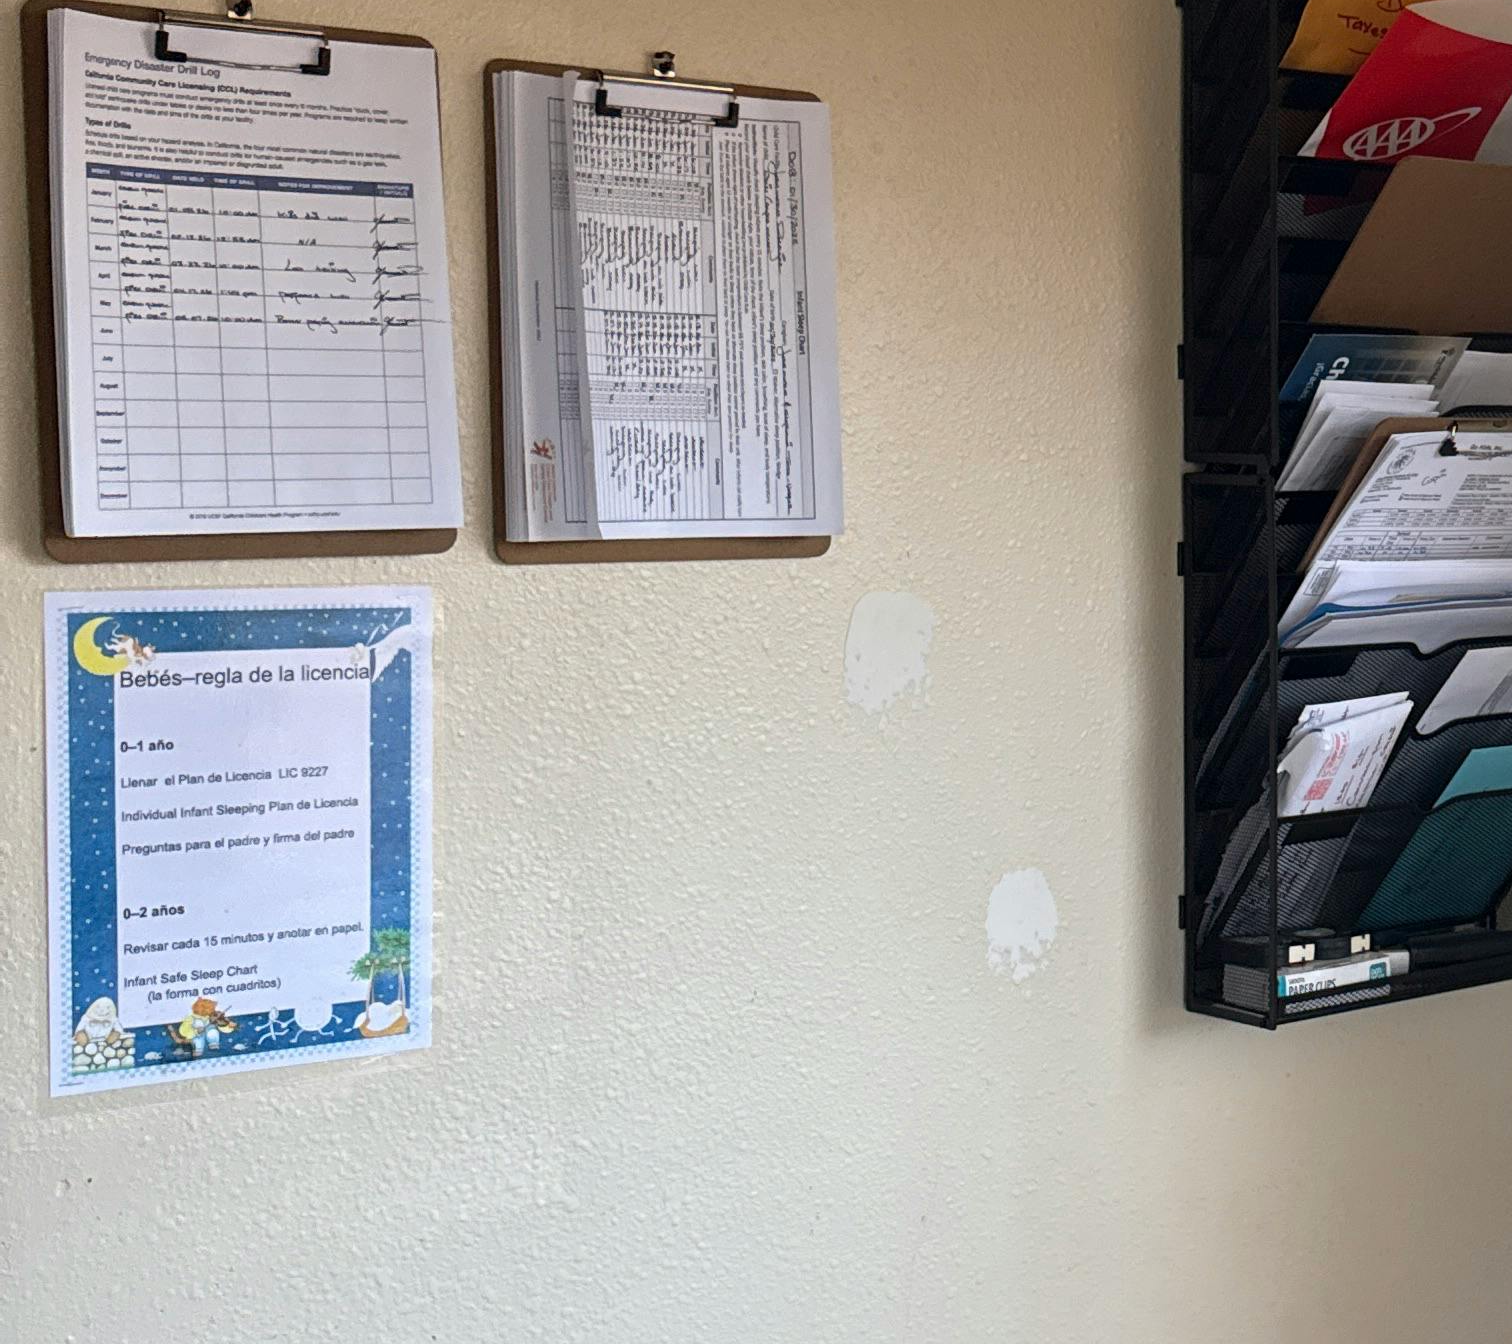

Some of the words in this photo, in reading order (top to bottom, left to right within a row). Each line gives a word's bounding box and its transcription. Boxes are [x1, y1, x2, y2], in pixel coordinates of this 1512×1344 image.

[85, 52, 132, 70] Emergency
[134, 59, 174, 73] Disaster
[178, 64, 197, 74] Drill
[201, 66, 220, 78] Log
[1350, 116, 1430, 157] AAA
[249, 667, 272, 682] de
[279, 665, 295, 681] la
[301, 663, 370, 681] licencia
[149, 739, 174, 751] año
[121, 778, 158, 788] Llenar
[165, 776, 175, 786] el
[179, 774, 204, 785] Plan
[208, 773, 222, 783] de
[226, 770, 272, 782] Licencia
[279, 768, 298, 779] LIC
[121, 808, 176, 822] Individual
[180, 806, 213, 818] Infant
[216, 803, 265, 815] Sleeping
[269, 801, 294, 811] Plan
[297, 800, 310, 810] de
[314, 797, 358, 809] Licencia
[122, 842, 181, 856] Preguntas
[185, 841, 211, 852] para
[215, 837, 224, 848] el
[228, 835, 260, 849] padre
[264, 836, 270, 847] y
[273, 833, 300, 843] firma
[323, 829, 355, 841] padre
[152, 905, 185, 917] años
[123, 942, 169, 955] Revisar
[172, 938, 200, 950] cada
[204, 936, 218, 947] 15
[221, 933, 264, 945] minutos
[268, 933, 274, 943] y
[277, 928, 312, 939] anotar
[315, 927, 328, 935] en
[332, 922, 364, 936] papel.
[124, 976, 157, 988] Infant
[161, 972, 187, 984] Safe
[191, 969, 223, 980] Sleep
[227, 965, 257, 977] Chart
[148, 991, 162, 1004] (la
[166, 988, 199, 1000] forma
[202, 986, 222, 995] con
